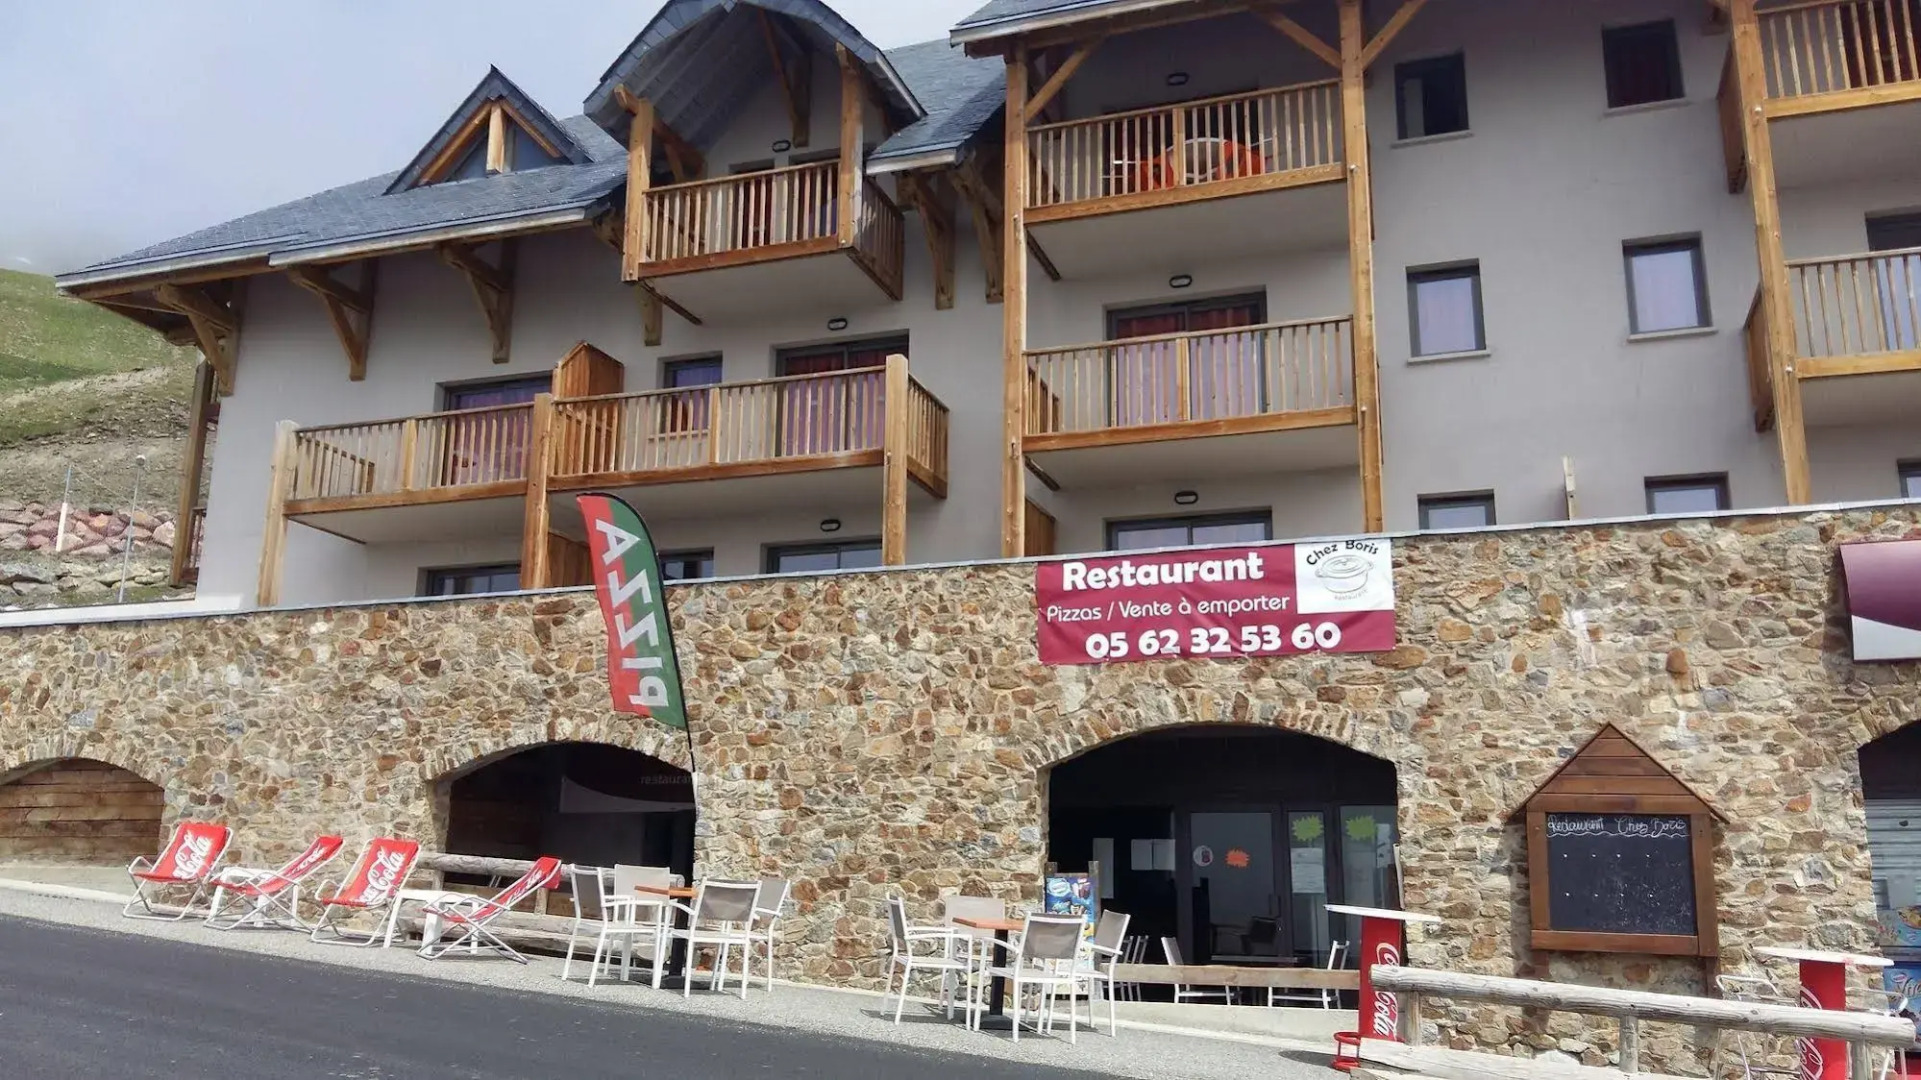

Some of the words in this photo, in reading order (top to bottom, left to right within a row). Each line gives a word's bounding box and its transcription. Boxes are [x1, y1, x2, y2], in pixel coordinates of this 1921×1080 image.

[1306, 543, 1339, 565] Chez
[1345, 539, 1379, 555] Boris
[1062, 553, 1264, 592] Restaurant
[1046, 605, 1102, 622] Pizzas
[1107, 601, 1115, 621] /
[1118, 600, 1173, 618] Vente
[1178, 597, 1192, 615] à
[1197, 596, 1290, 617] emporter
[1085, 632, 1129, 658] 05
[1138, 629, 1181, 655] 62
[1190, 626, 1232, 653] 32
[1241, 624, 1282, 652] 53
[1291, 621, 1342, 649] 60
